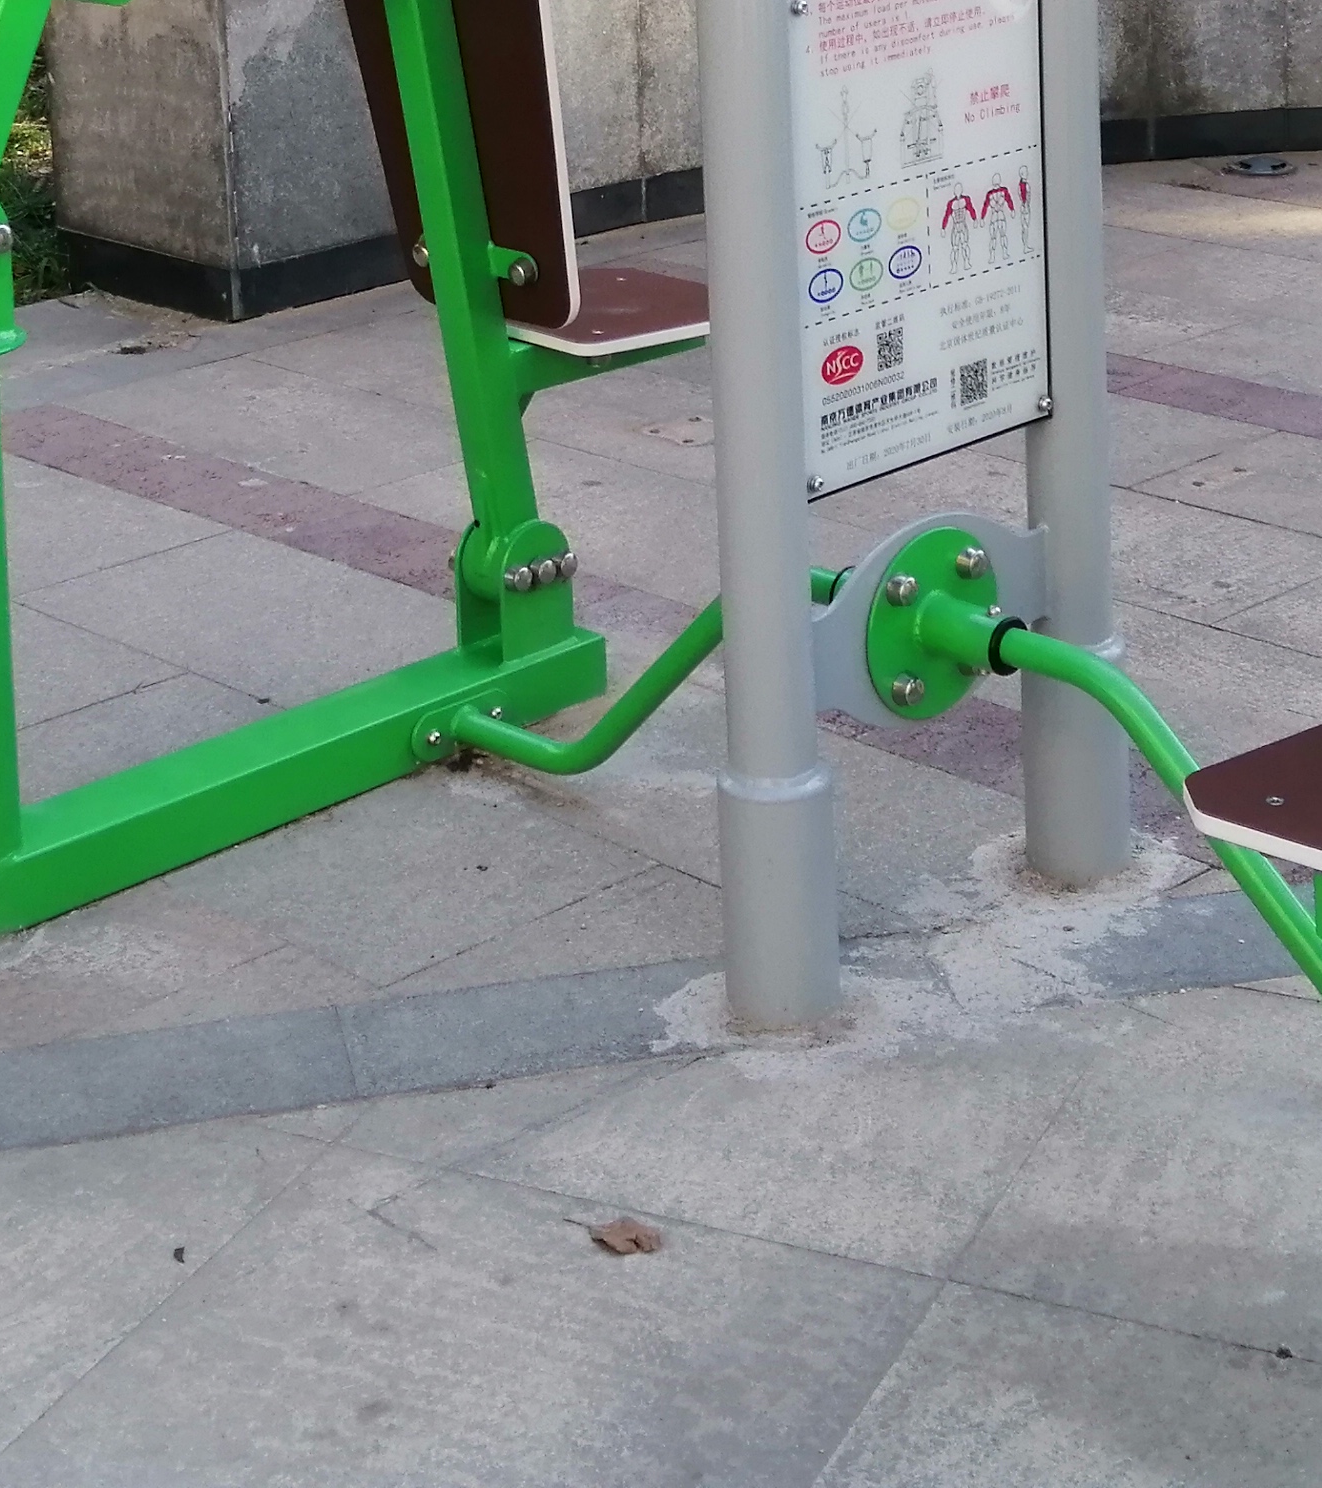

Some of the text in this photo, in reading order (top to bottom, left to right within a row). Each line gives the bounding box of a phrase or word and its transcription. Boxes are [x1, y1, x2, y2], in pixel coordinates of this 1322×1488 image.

[969, 82, 1011, 106] 禁止攀爬
[964, 102, 1021, 124] No Climbing
[825, 350, 861, 378] NSCC
